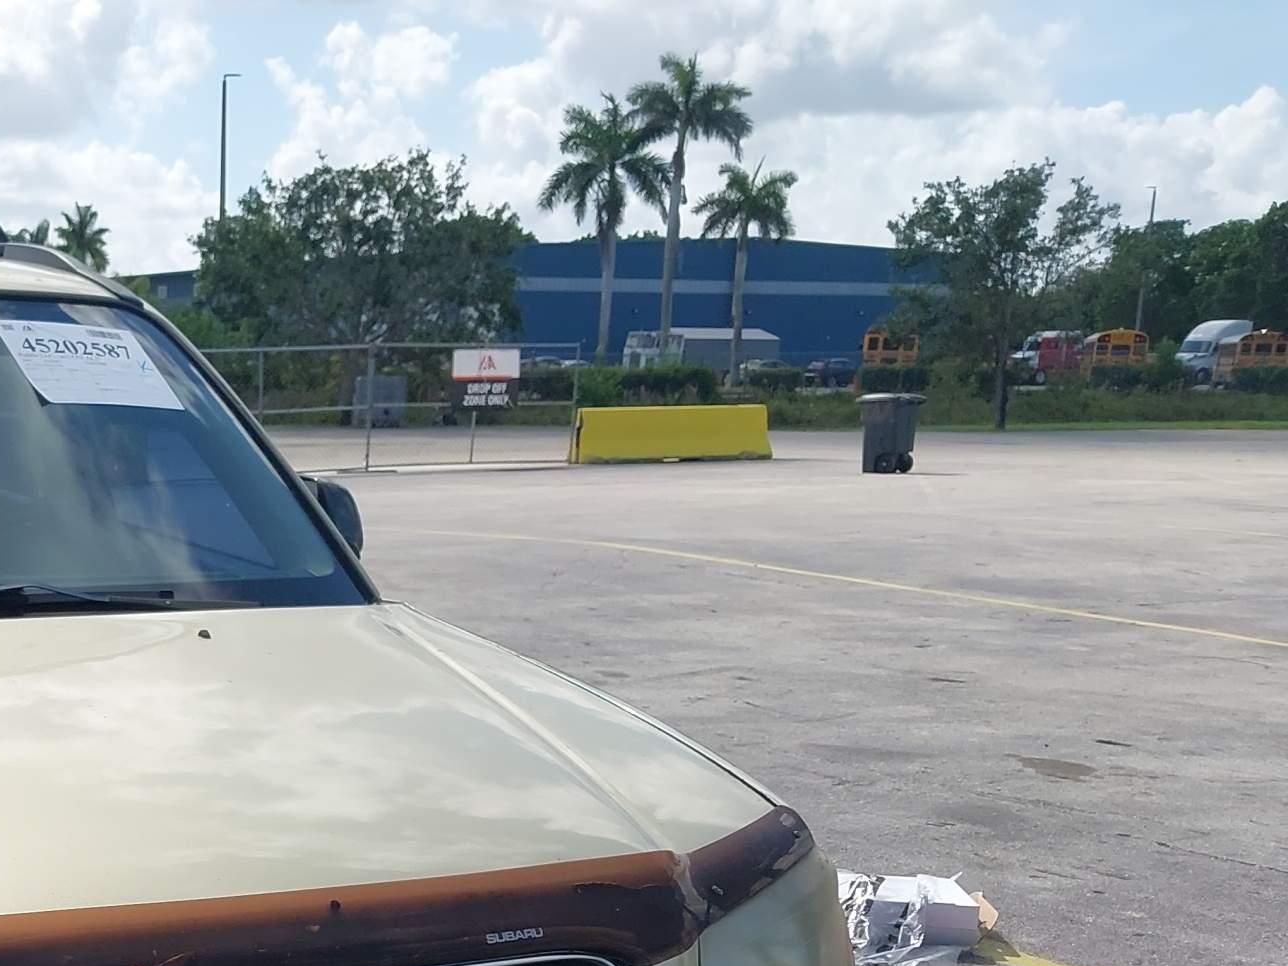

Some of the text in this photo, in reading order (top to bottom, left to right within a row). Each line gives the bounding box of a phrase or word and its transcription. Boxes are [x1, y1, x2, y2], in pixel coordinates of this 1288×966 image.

[21, 337, 132, 360] 45202587
[467, 383, 507, 394] DROP OFF
[463, 394, 511, 407] ZONE ONLY
[485, 927, 544, 944] SUBARU
